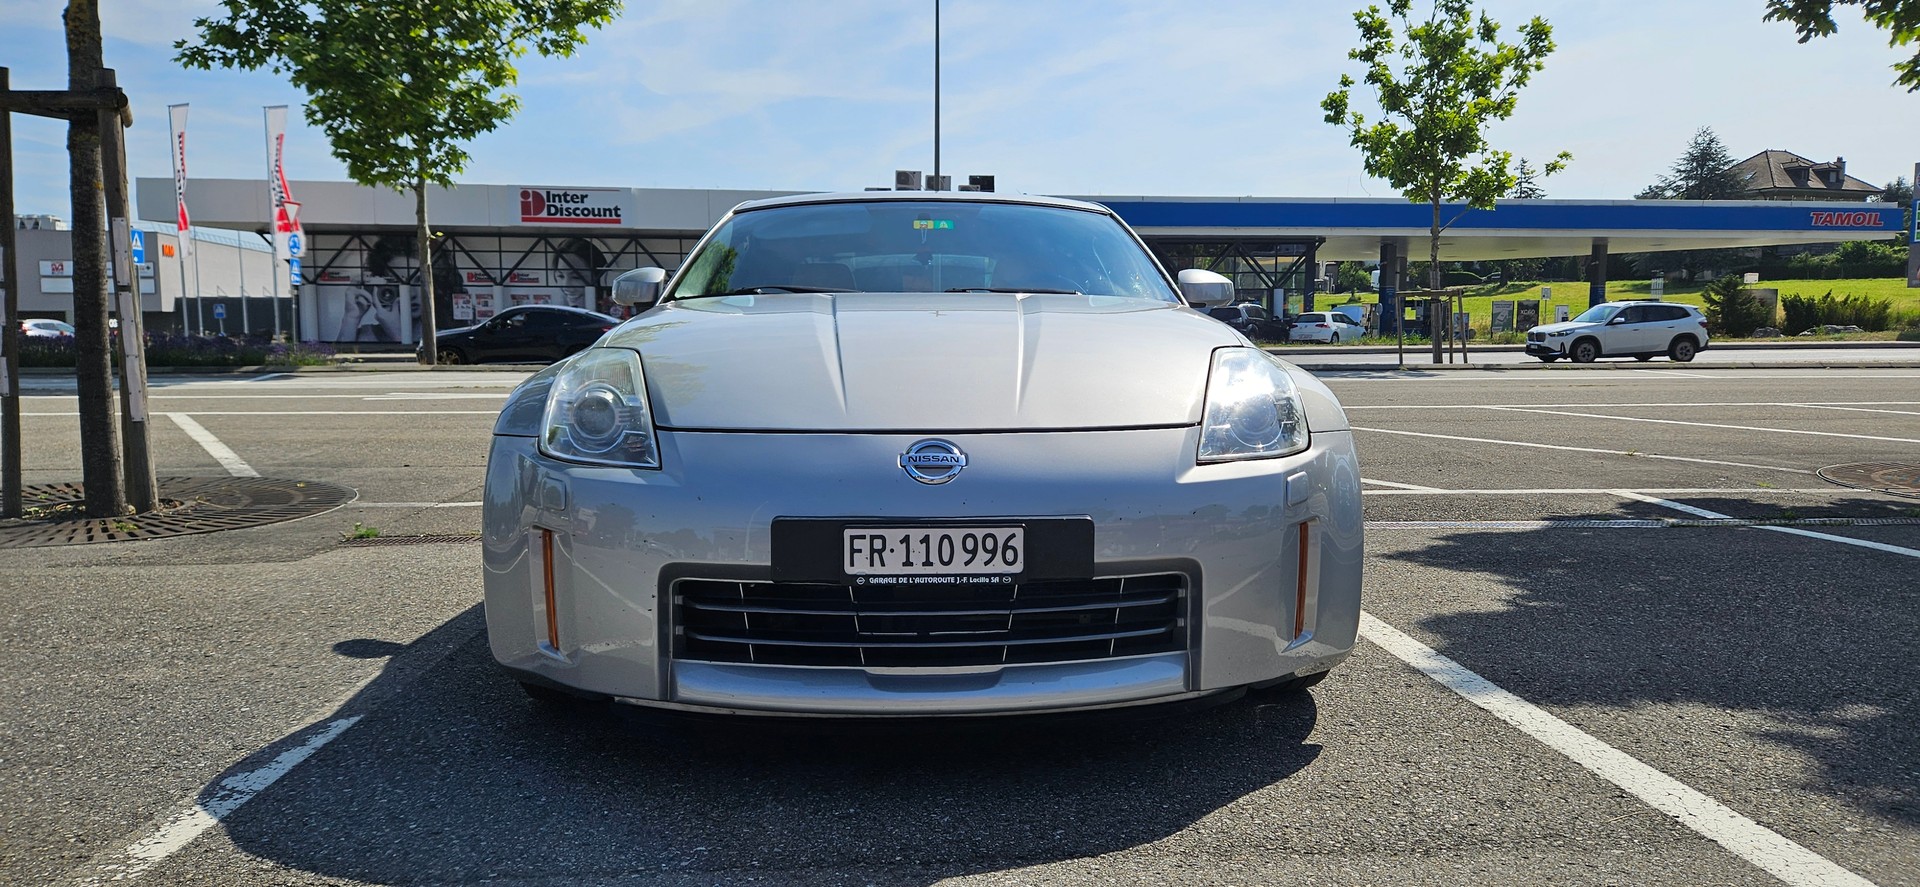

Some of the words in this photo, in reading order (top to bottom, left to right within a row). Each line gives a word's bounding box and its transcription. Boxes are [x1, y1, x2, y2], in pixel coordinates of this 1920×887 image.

[546, 190, 588, 204] Inter
[546, 204, 621, 217] Discount
[1811, 212, 1883, 226] TAMOIL
[908, 455, 959, 463] NISSAN
